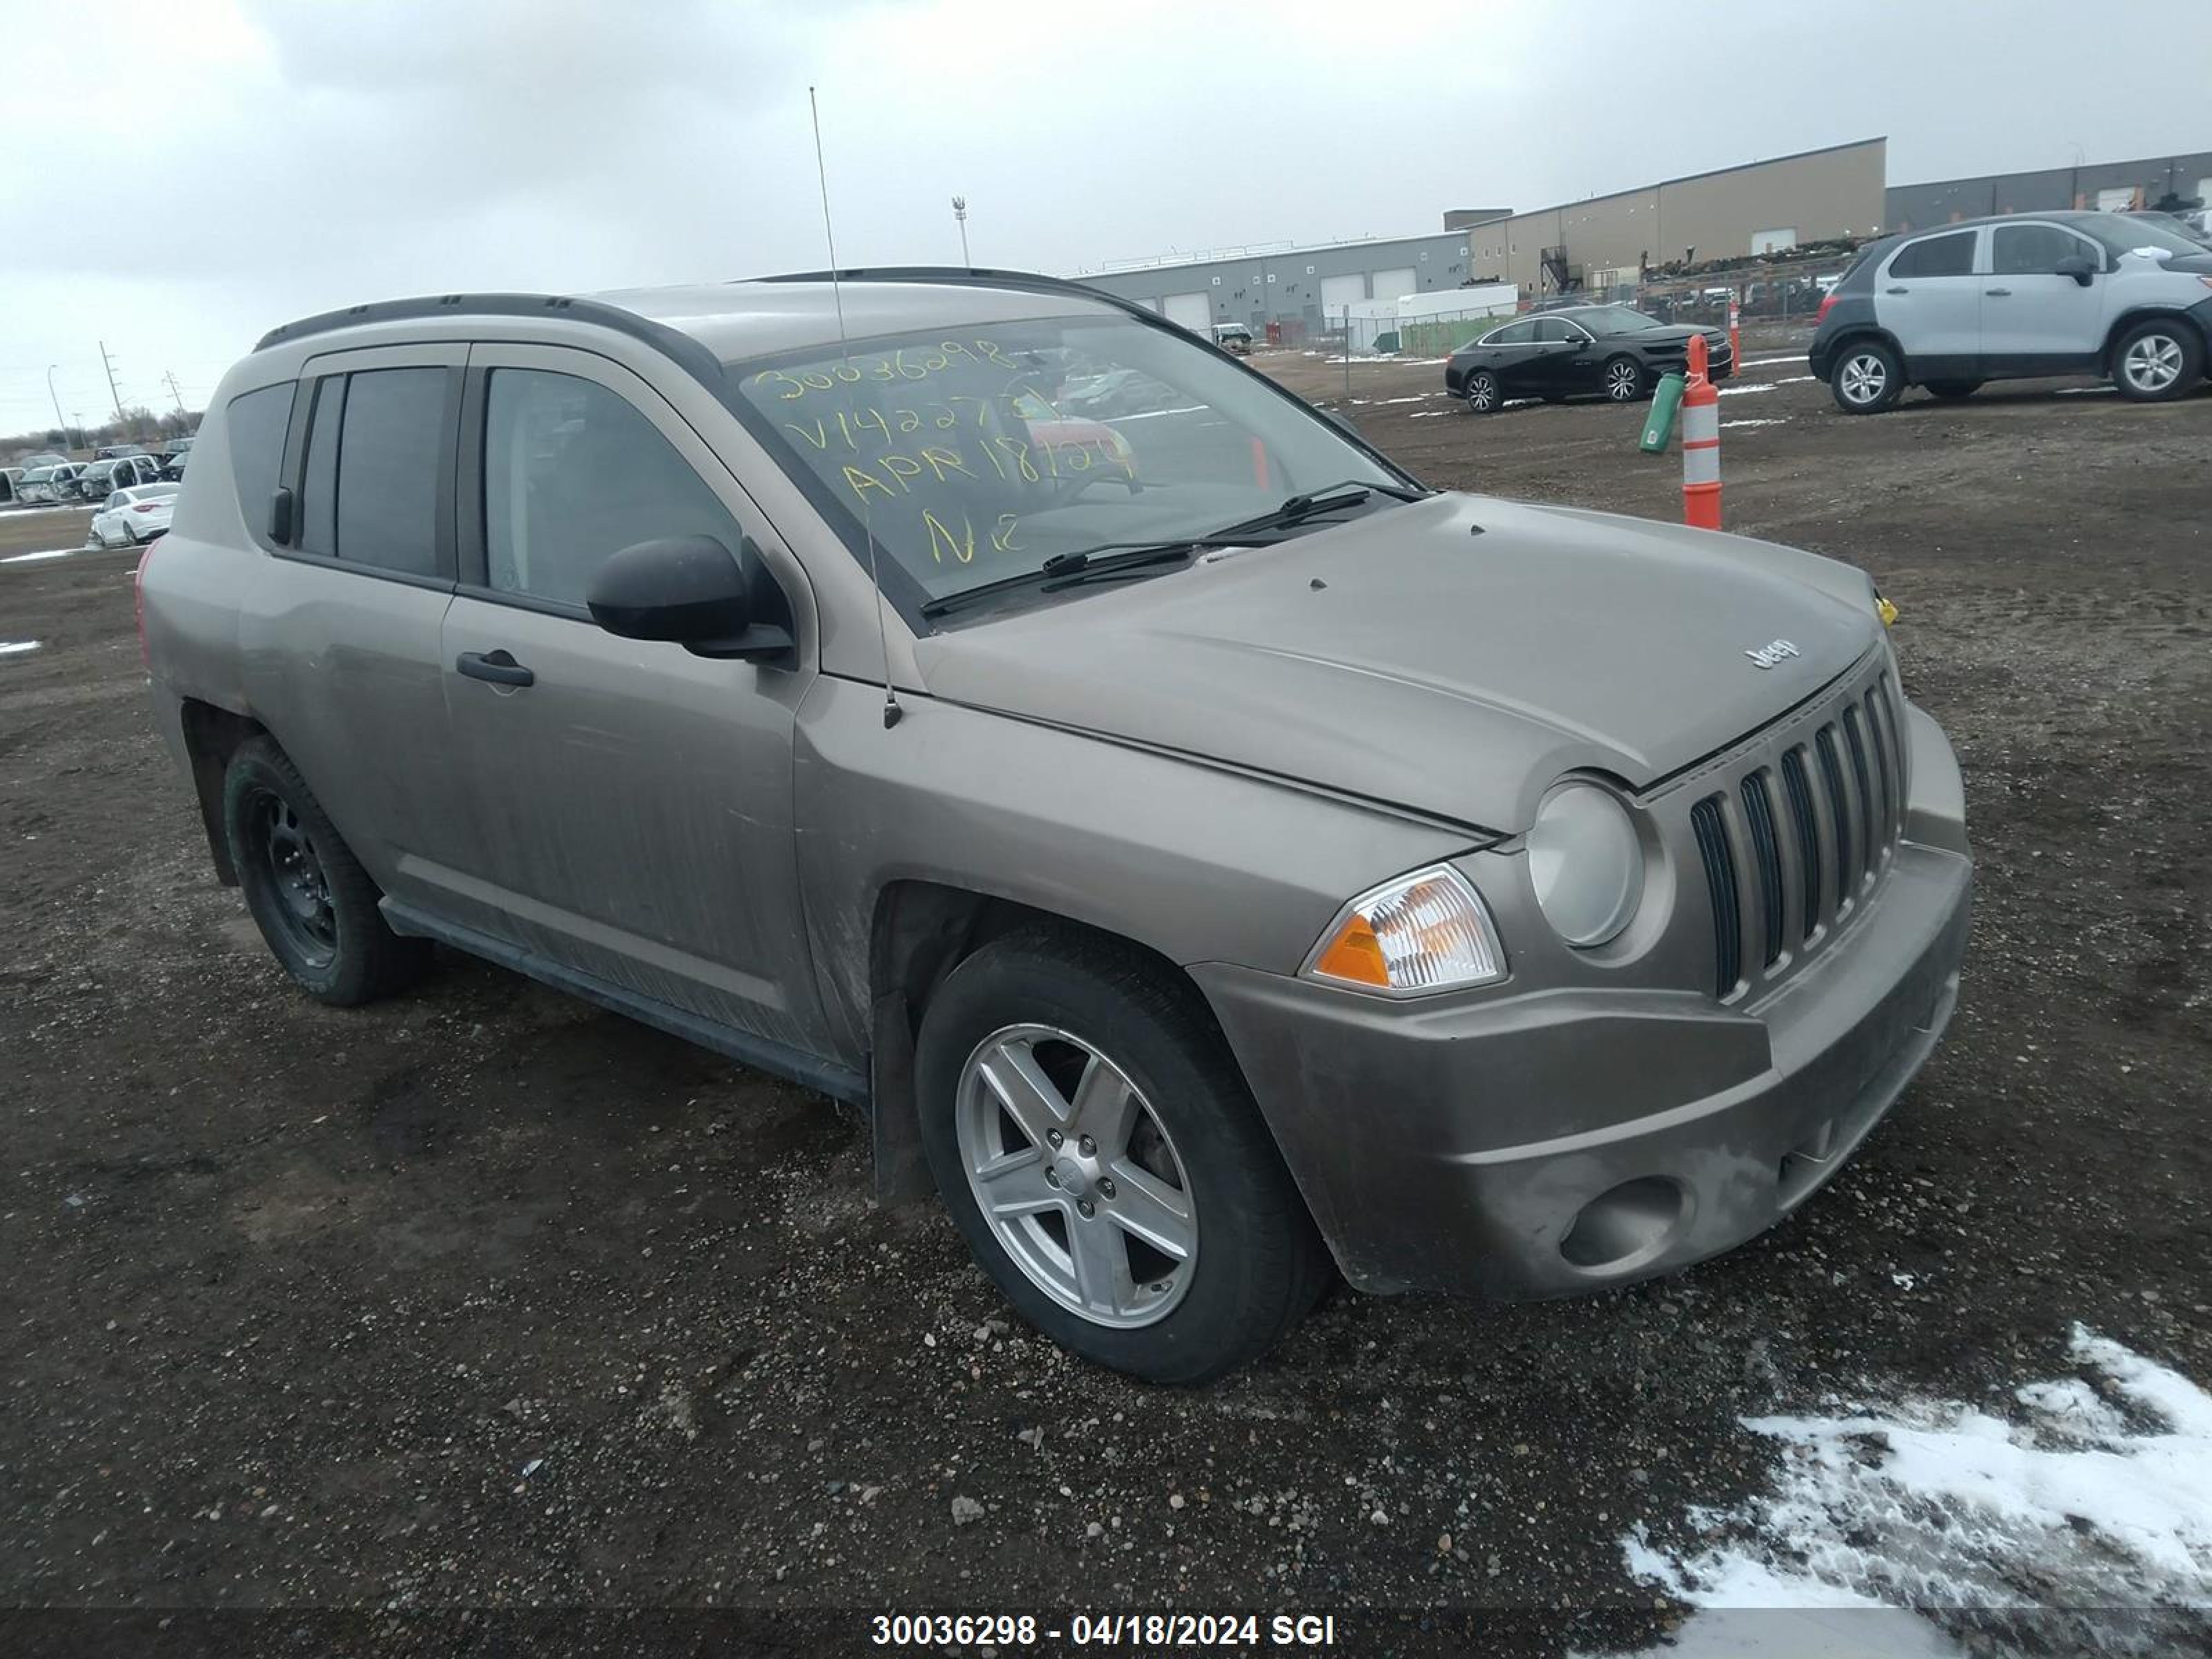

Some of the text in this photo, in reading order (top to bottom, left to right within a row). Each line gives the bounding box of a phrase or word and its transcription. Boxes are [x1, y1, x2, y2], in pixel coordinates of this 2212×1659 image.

[755, 341, 1017, 399] 30036298
[842, 448, 978, 505] APR
[1744, 639, 1801, 669] Jeep
